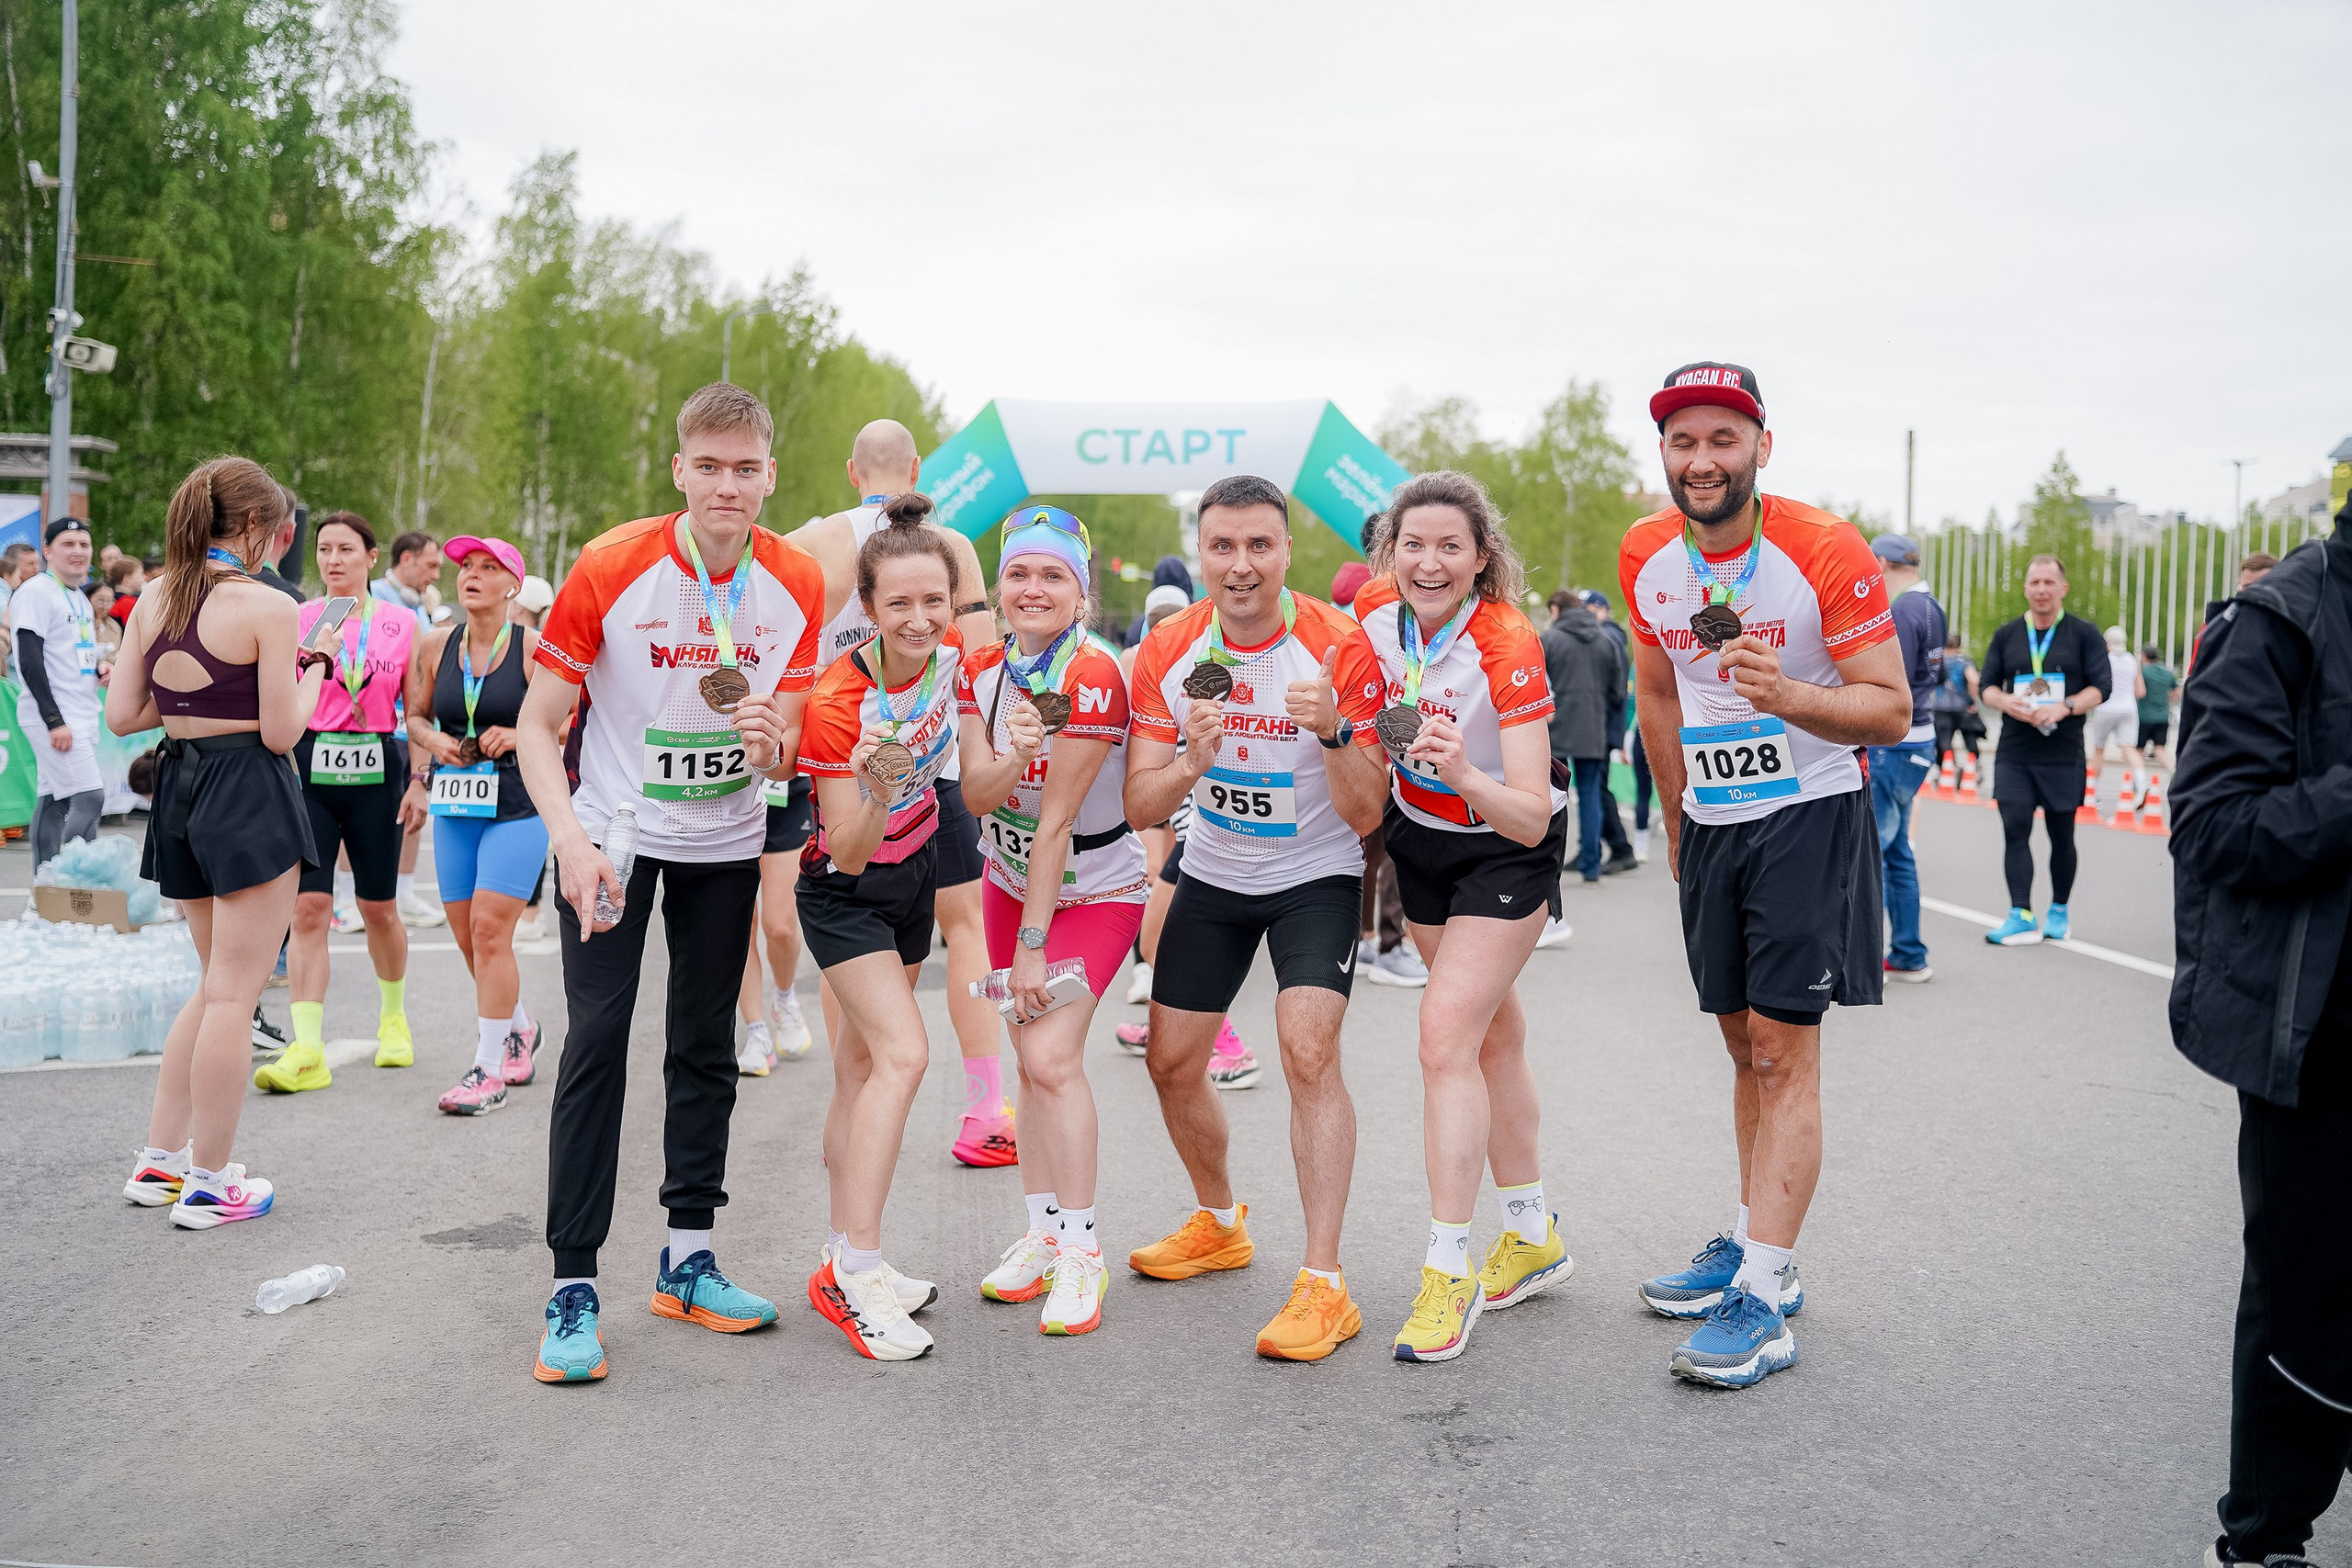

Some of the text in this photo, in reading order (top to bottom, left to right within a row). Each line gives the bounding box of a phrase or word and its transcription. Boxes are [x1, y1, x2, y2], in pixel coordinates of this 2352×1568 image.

[1076, 428, 1246, 466] СТАРТ
[680, 646, 761, 665] НЯГНЬ
[1234, 731, 1279, 741] ЛЮБИТЕЛЕЙ
[322, 749, 376, 769] 1616
[658, 749, 746, 780] 1152
[902, 753, 944, 797] 533
[1695, 743, 1781, 780] 1028
[439, 779, 489, 799] 1010
[1210, 784, 1272, 818] 955
[990, 821, 1035, 860] 132
